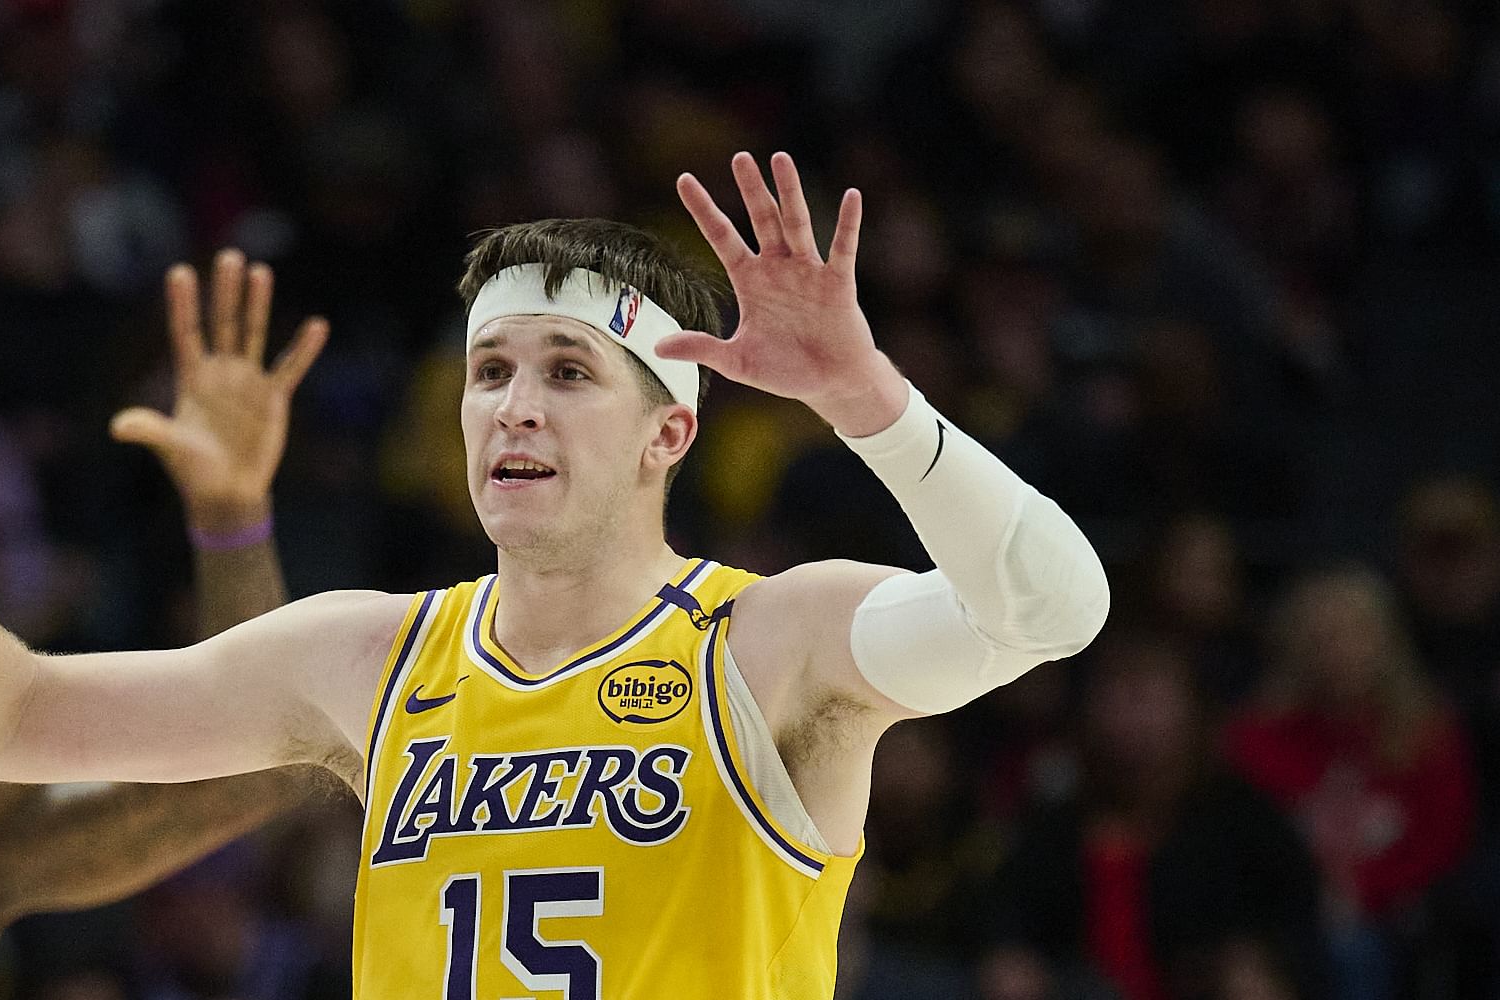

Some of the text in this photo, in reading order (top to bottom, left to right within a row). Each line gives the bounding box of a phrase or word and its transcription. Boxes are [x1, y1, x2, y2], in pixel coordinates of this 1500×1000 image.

[607, 675, 688, 705] bibigo
[619, 698, 654, 709] 비비고
[369, 735, 693, 869] LAKERS
